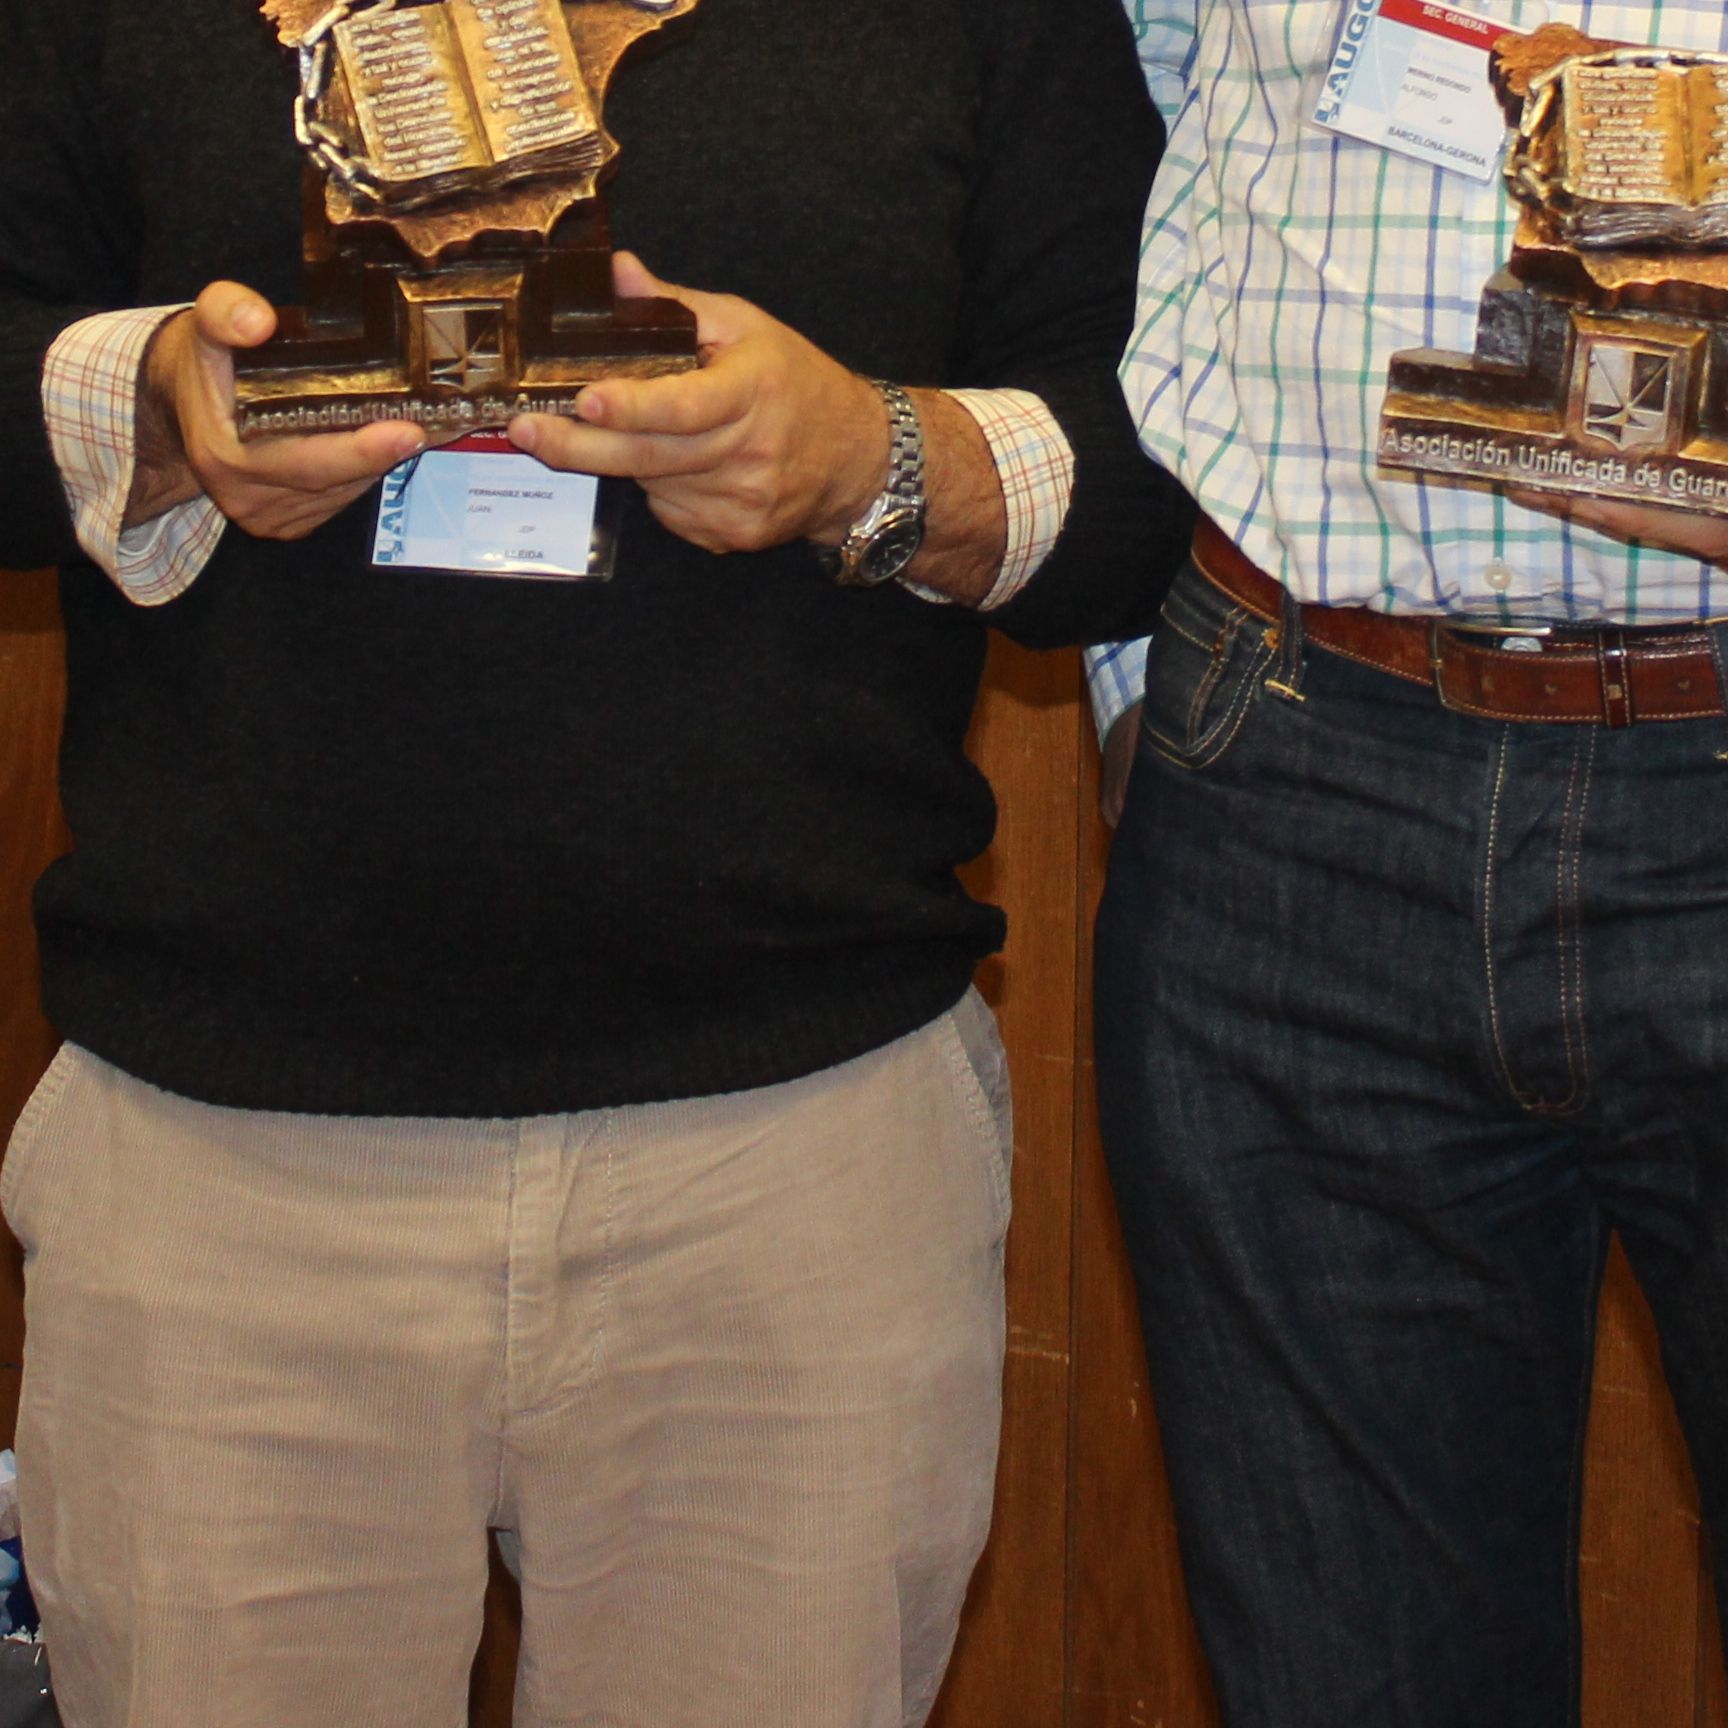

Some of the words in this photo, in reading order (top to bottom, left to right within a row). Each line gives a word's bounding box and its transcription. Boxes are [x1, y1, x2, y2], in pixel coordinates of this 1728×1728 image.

[1444, 11, 1489, 35] GENERAL
[1387, 125, 1487, 168] BARCELONA-GERONA
[1380, 428, 1512, 467] Asociación
[1517, 445, 1627, 486] Unificada
[1635, 464, 1661, 489] de
